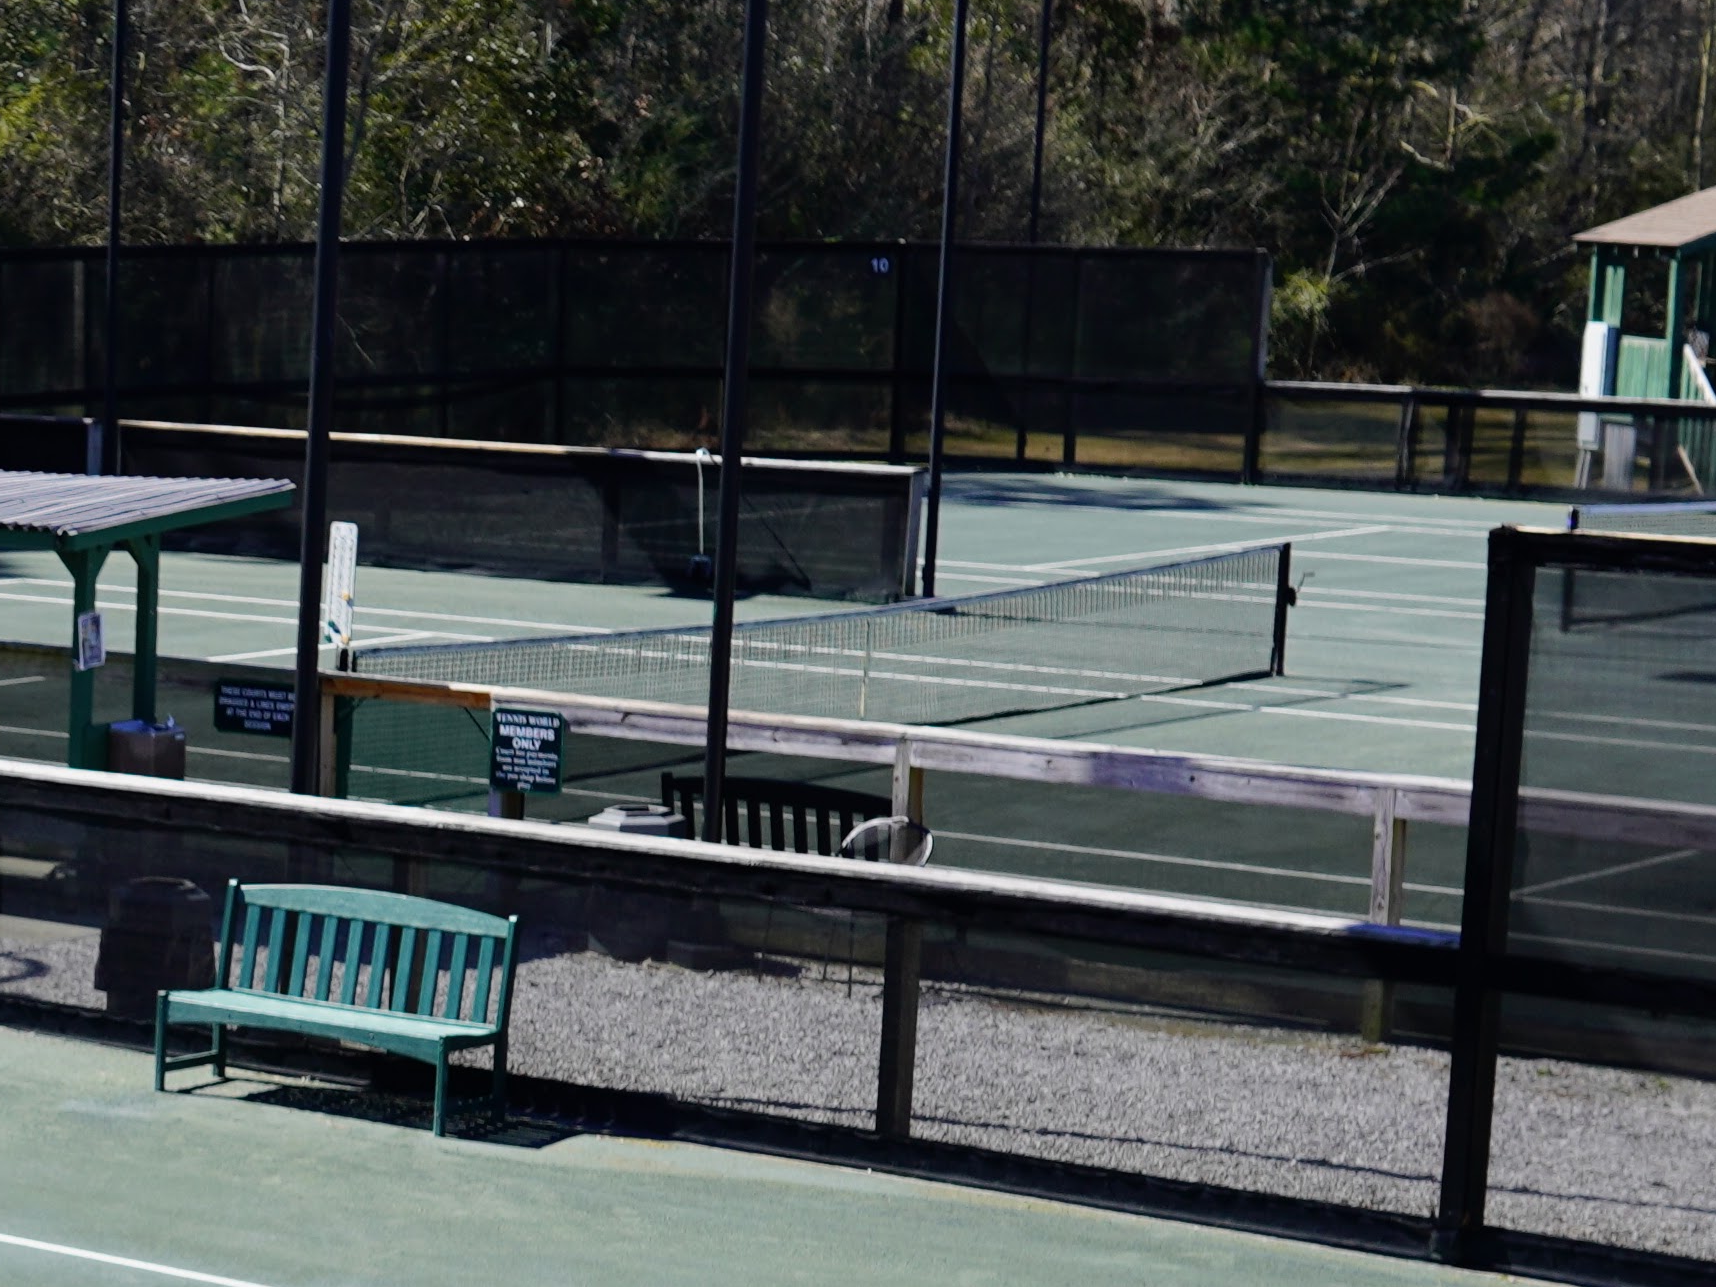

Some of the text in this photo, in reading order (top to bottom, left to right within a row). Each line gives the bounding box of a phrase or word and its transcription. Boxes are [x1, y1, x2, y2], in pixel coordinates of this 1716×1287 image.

[871, 257, 889, 273] 10
[496, 713, 560, 728] TENNIS WORLD
[499, 724, 555, 741] MEMBERS
[512, 736, 541, 751] ONLY
